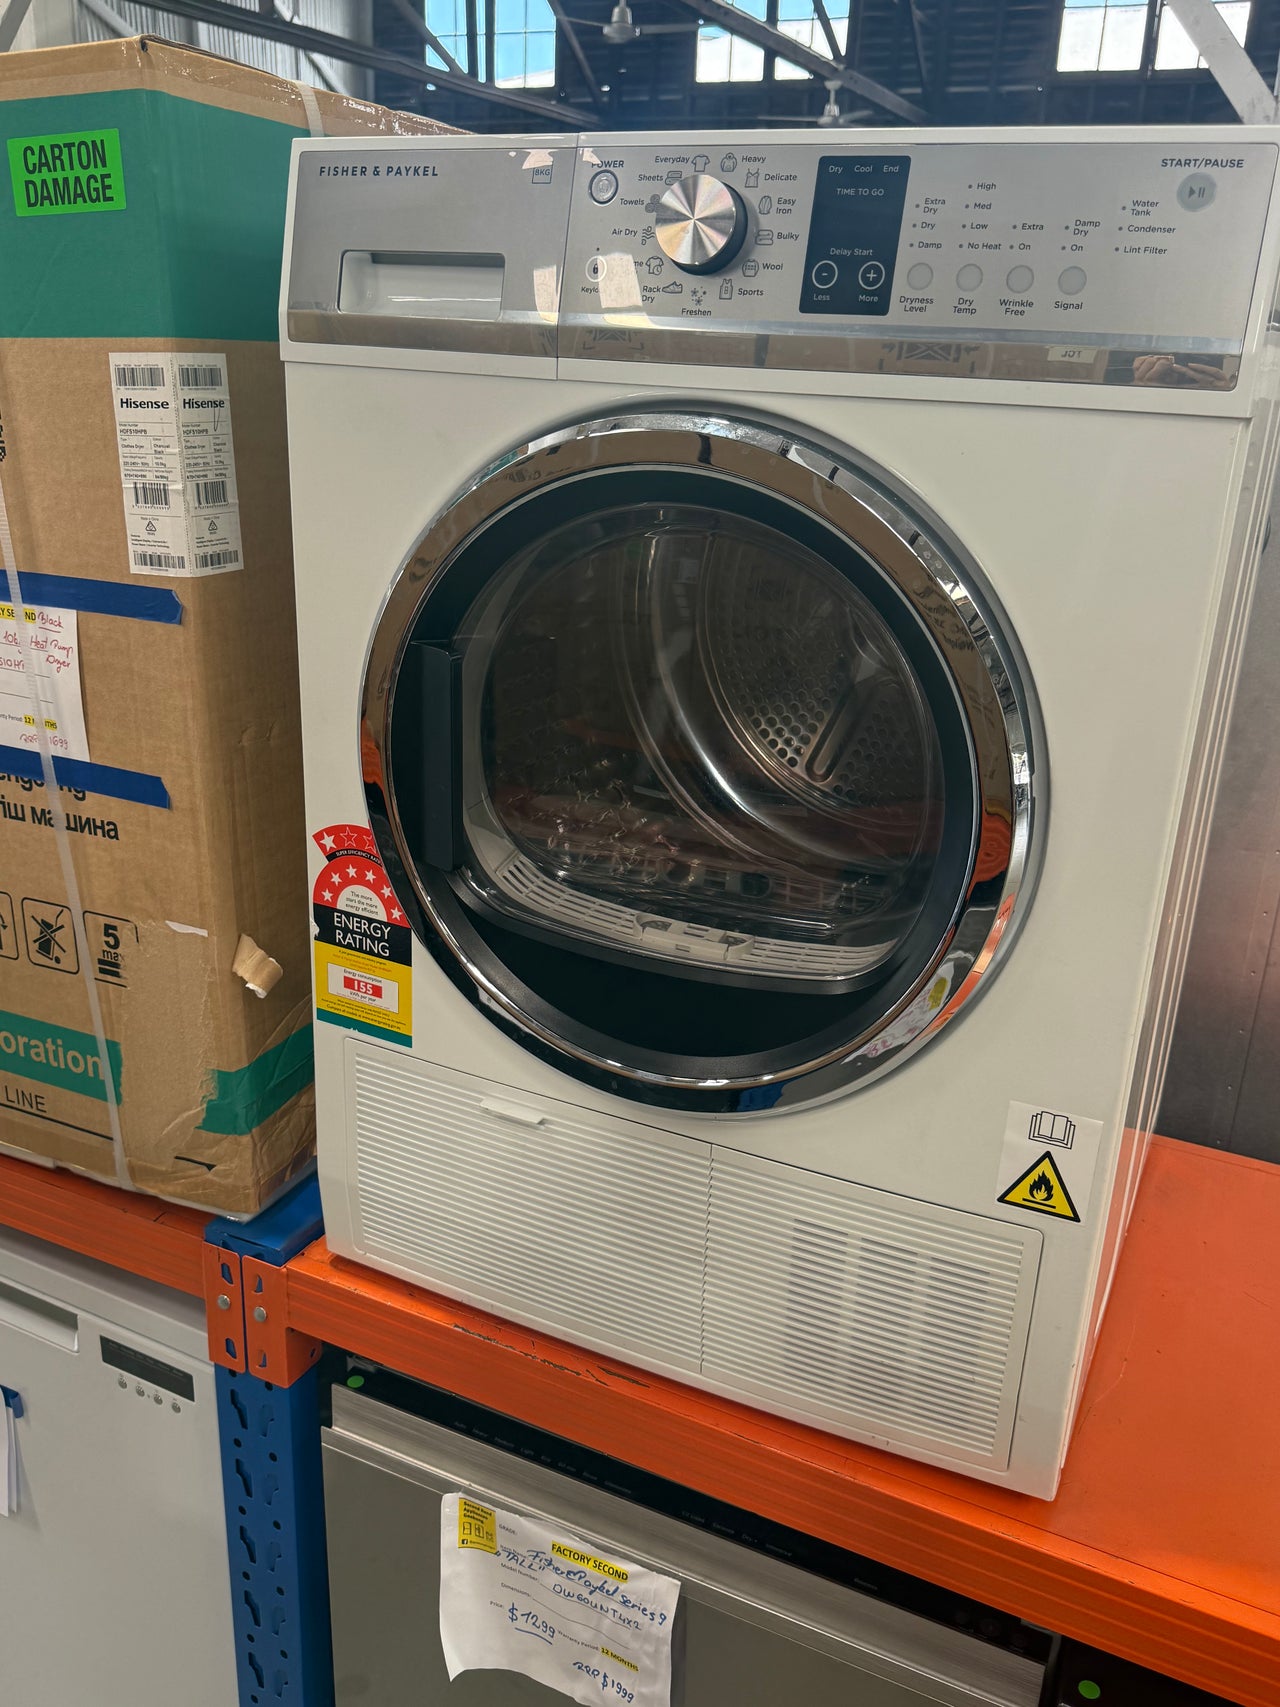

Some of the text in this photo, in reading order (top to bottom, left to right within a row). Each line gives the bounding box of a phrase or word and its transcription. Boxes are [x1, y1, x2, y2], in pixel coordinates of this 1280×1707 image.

[23, 139, 107, 175] CARTON
[655, 155, 766, 165] Everyday Heavy
[1160, 158, 1245, 169] START/PAUSE
[319, 166, 439, 177] FISHER & PAYKEL
[534, 168, 551, 176] 8KG
[828, 165, 843, 174] Dry
[854, 165, 873, 173] Cool
[883, 165, 900, 173] End
[638, 174, 664, 182] Sheets
[764, 173, 798, 182] Delicate
[24, 173, 114, 208] DAMAGE
[977, 182, 997, 191] High
[836, 188, 885, 196] TIME TO GO
[620, 198, 645, 206] Towels
[777, 198, 797, 207] Easy
[924, 198, 946, 206] Extra
[1132, 200, 1160, 208] Water
[776, 207, 792, 215] Iron
[923, 207, 938, 215] Dry
[1131, 209, 1152, 217] Tank
[921, 222, 936, 230] Dry
[970, 222, 989, 230] Low
[1021, 223, 1045, 231] Extra
[1074, 220, 1101, 228] Damp
[612, 228, 638, 238] Air Dry
[1073, 228, 1089, 237] Dry
[1127, 225, 1176, 234] Condenser
[777, 232, 800, 241] Bulky
[918, 242, 942, 250] Damp
[967, 242, 1002, 250] No Heat
[1018, 243, 1031, 251] On
[1070, 244, 1084, 252] On
[1123, 246, 1168, 255] Lint Filter
[830, 248, 873, 256] Delay Start
[762, 263, 784, 271] Wool
[581, 286, 600, 295] Keylo
[642, 285, 661, 294] Rack
[738, 288, 764, 297] Sports
[641, 294, 655, 304] Dry
[813, 293, 830, 301] Less
[858, 294, 878, 302] More
[899, 296, 934, 305] Dryness
[957, 298, 974, 307] Dry
[999, 299, 1034, 308] Wrinkle
[1054, 300, 1083, 310] Signal
[681, 308, 712, 317] Freshen
[904, 305, 927, 313] Level
[953, 306, 977, 315] Temp
[1004, 307, 1026, 316] Free
[120, 398, 170, 409] Hisense
[183, 398, 225, 409] Hisense
[7, 609, 36, 621] SEND
[38, 611, 64, 629] Black
[30, 634, 48, 649] Heat
[50, 639, 73, 659] Pump
[46, 654, 71, 673] Dryer
[334, 912, 391, 940] ENERGY
[103, 923, 120, 950] 5
[336, 929, 390, 957] RATING
[102, 949, 125, 962] max
[343, 968, 382, 984] Energy consumption
[354, 980, 373, 995] 155
[0, 1031, 105, 1080] oration
[5, 1085, 47, 1113] LINE
[552, 1544, 629, 1581] FACTORY SECOND
[527, 1549, 565, 1576] Fisher
[620, 1594, 656, 1621] Series
[508, 1602, 556, 1639] $1299
[601, 1647, 609, 1656] 12
[608, 1652, 639, 1671] MONTHS
[573, 1661, 634, 1703] RRP $1999
